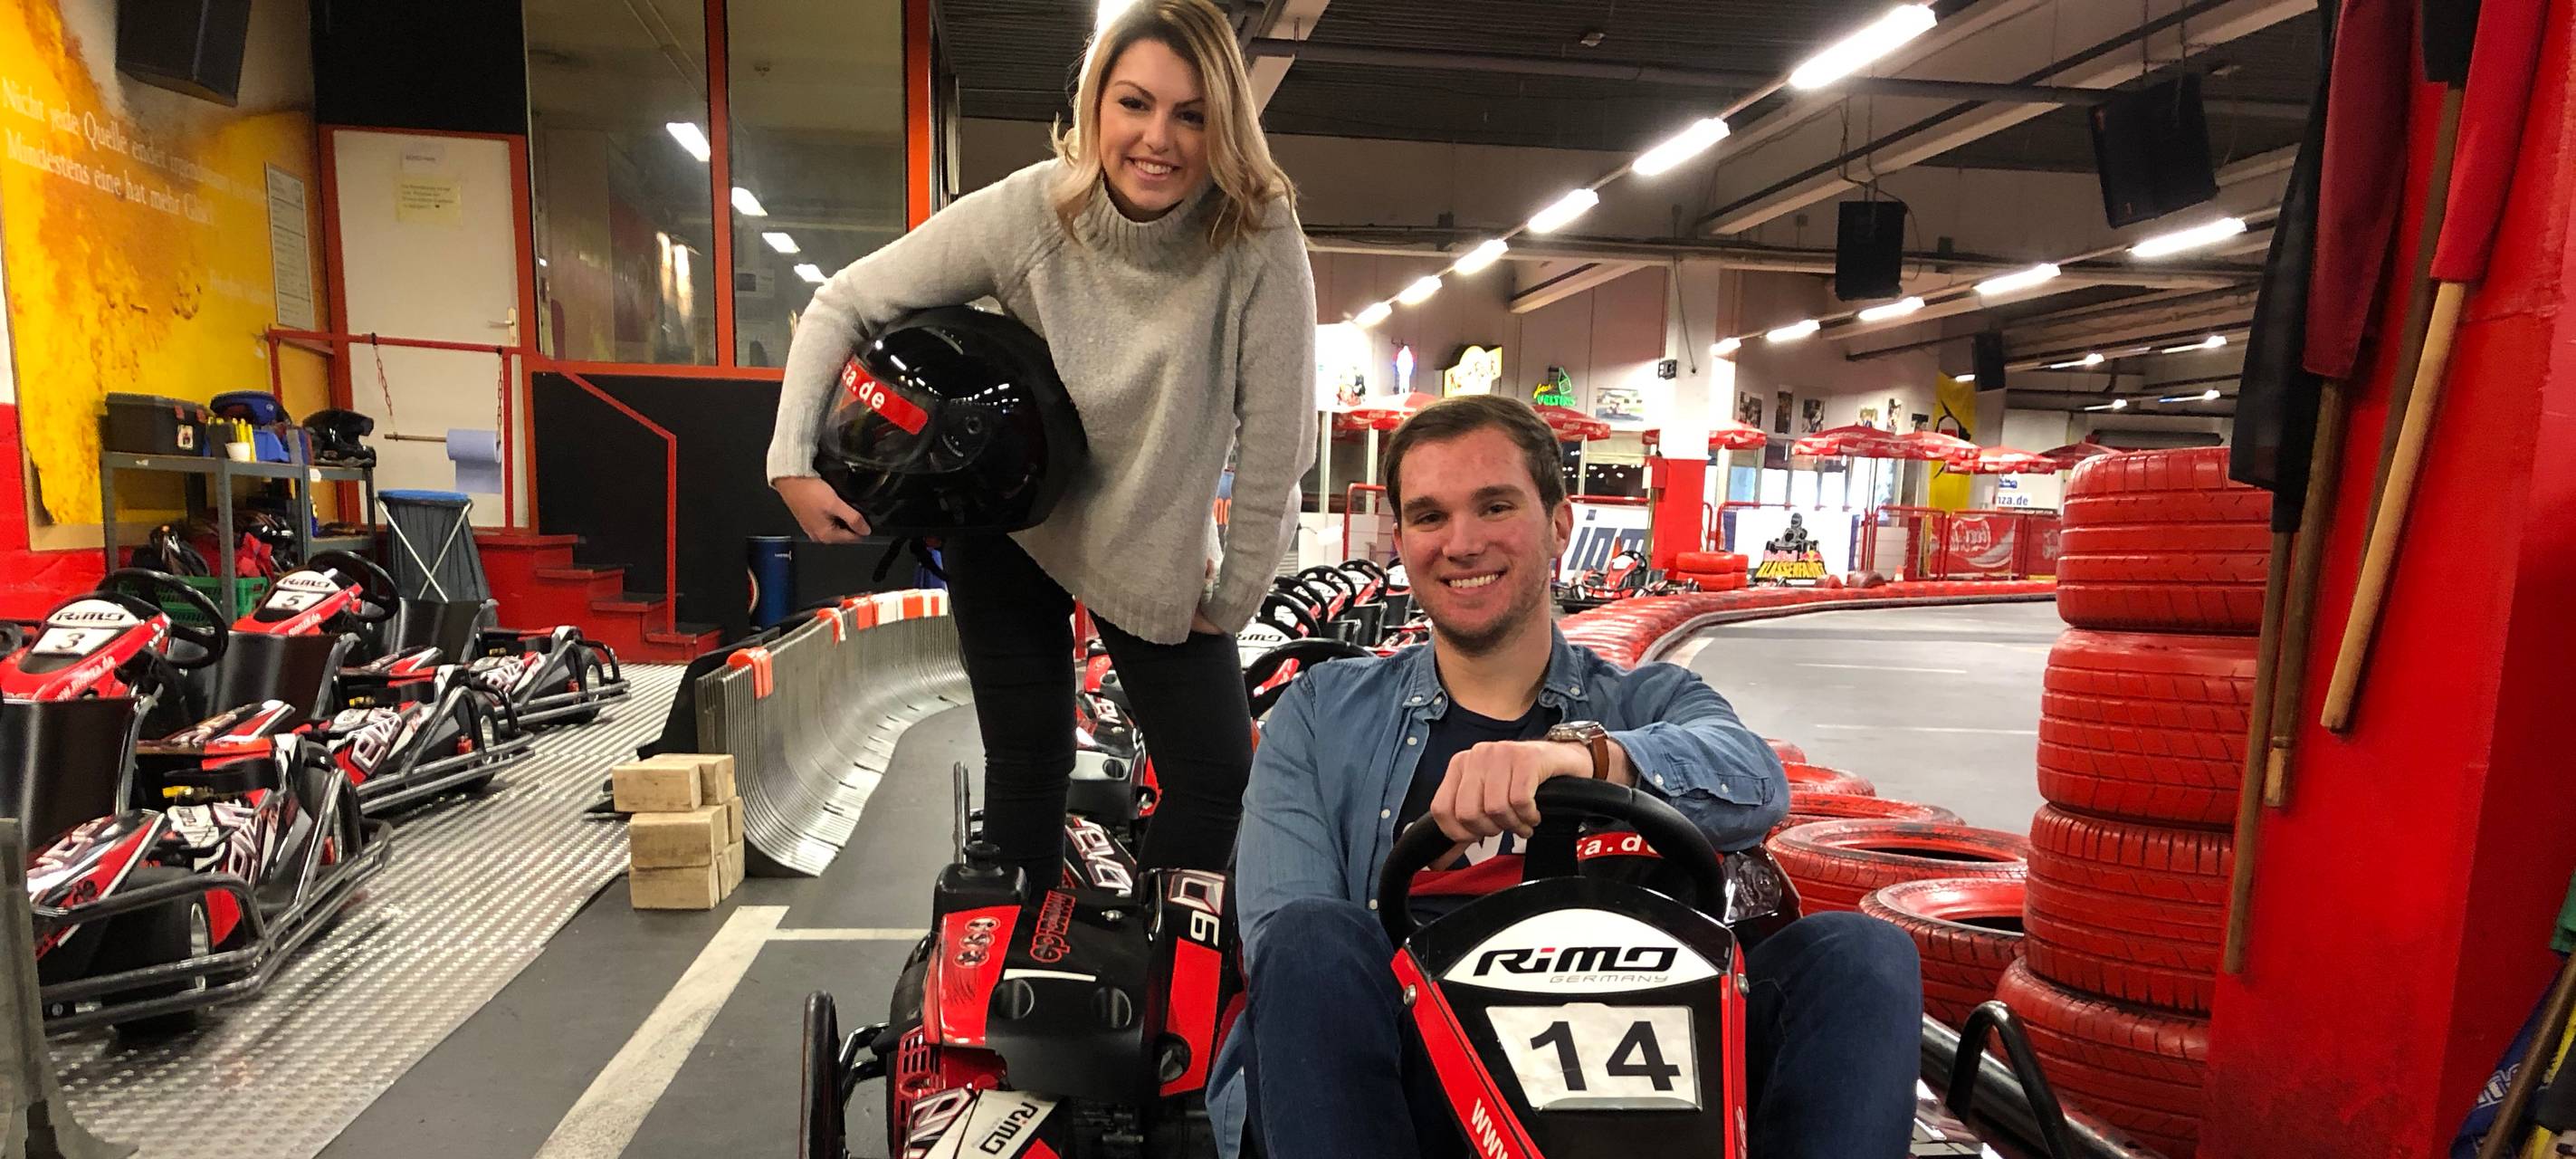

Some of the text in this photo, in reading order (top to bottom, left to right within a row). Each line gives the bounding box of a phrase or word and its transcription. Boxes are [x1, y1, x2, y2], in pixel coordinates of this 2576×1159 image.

[2, 76, 44, 122] Nicht
[48, 101, 80, 135] jede
[83, 110, 128, 154] Quelle
[5, 127, 91, 185] Mindestens
[94, 165, 120, 196] eine
[124, 169, 146, 205] hat
[150, 184, 180, 215] mehr
[281, 594, 305, 607] 5
[55, 633, 85, 650] 3
[1576, 832, 1659, 857] a.d
[1550, 975, 1669, 984] GERMANY
[1530, 1020, 1681, 1092] 14
